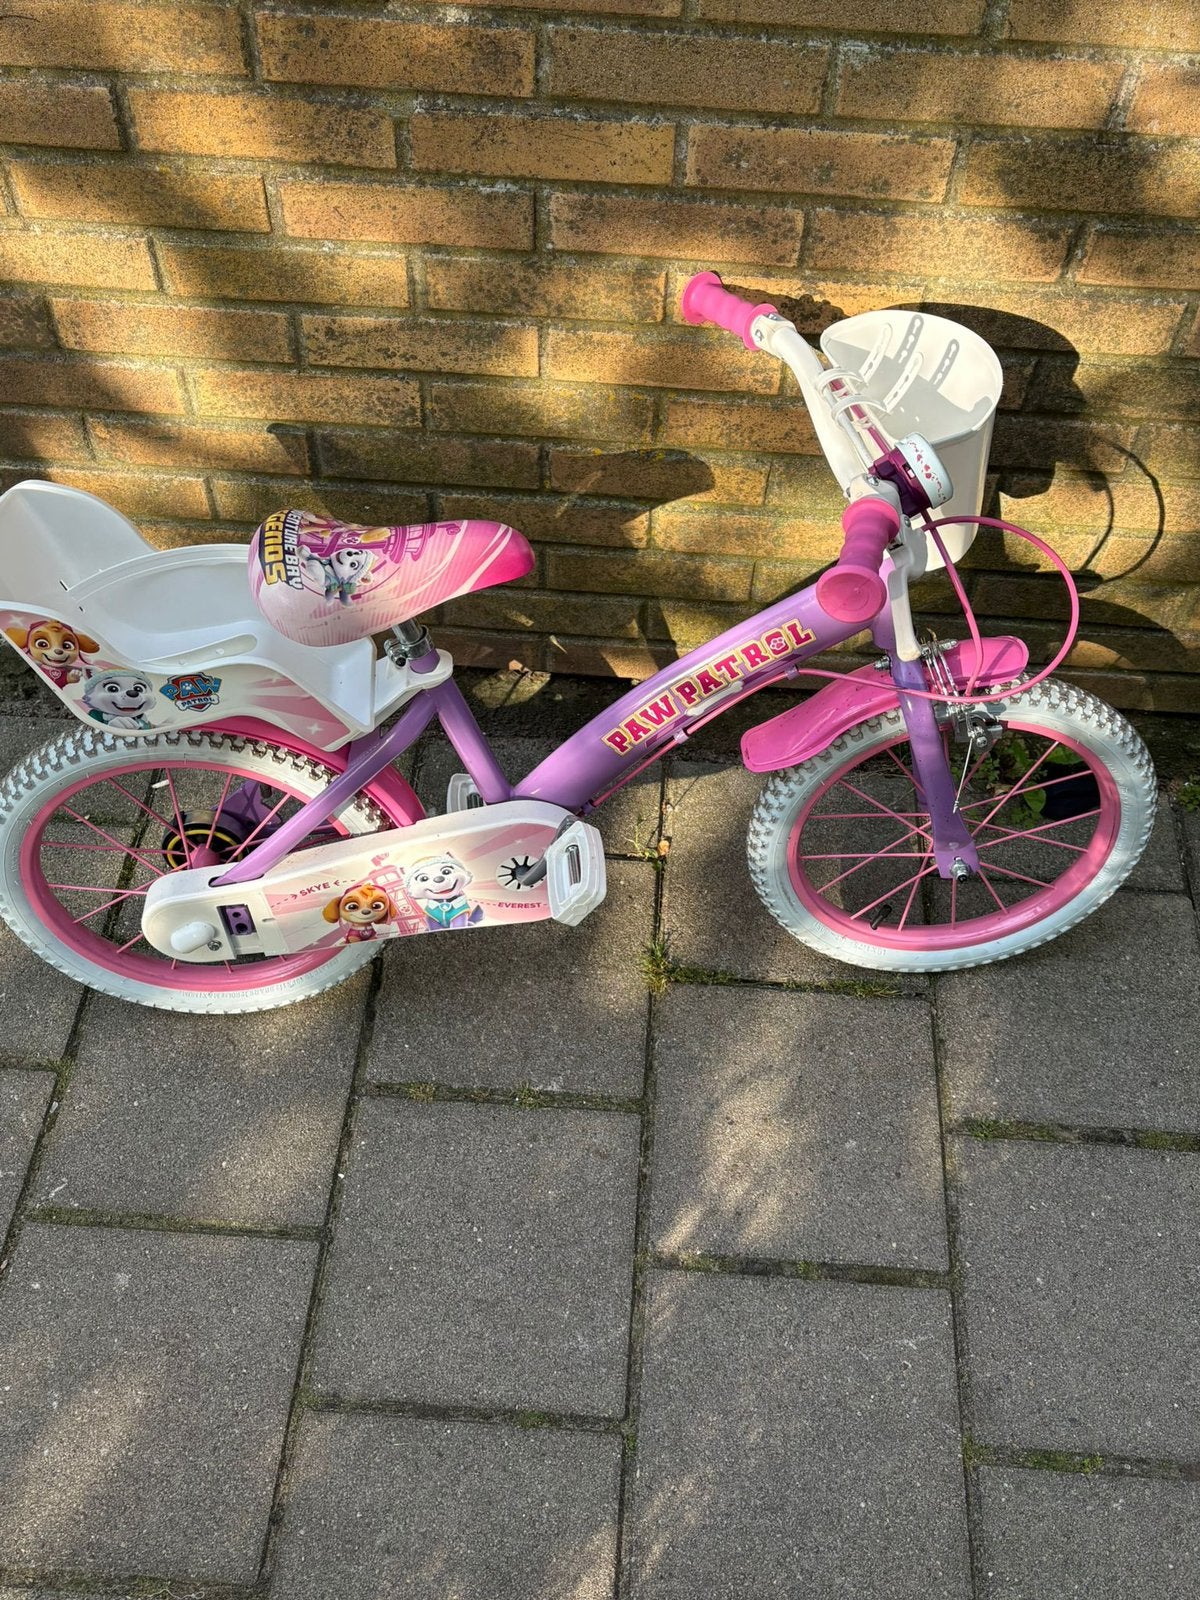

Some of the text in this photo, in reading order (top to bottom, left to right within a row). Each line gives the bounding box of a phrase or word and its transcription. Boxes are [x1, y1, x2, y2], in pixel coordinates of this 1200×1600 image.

[265, 509, 288, 585] GENDS
[286, 554, 304, 589] BAY
[159, 676, 222, 701] PAW
[180, 696, 215, 707] PATROL
[602, 619, 816, 756] PAW PATROL
[300, 882, 330, 896] SKYE
